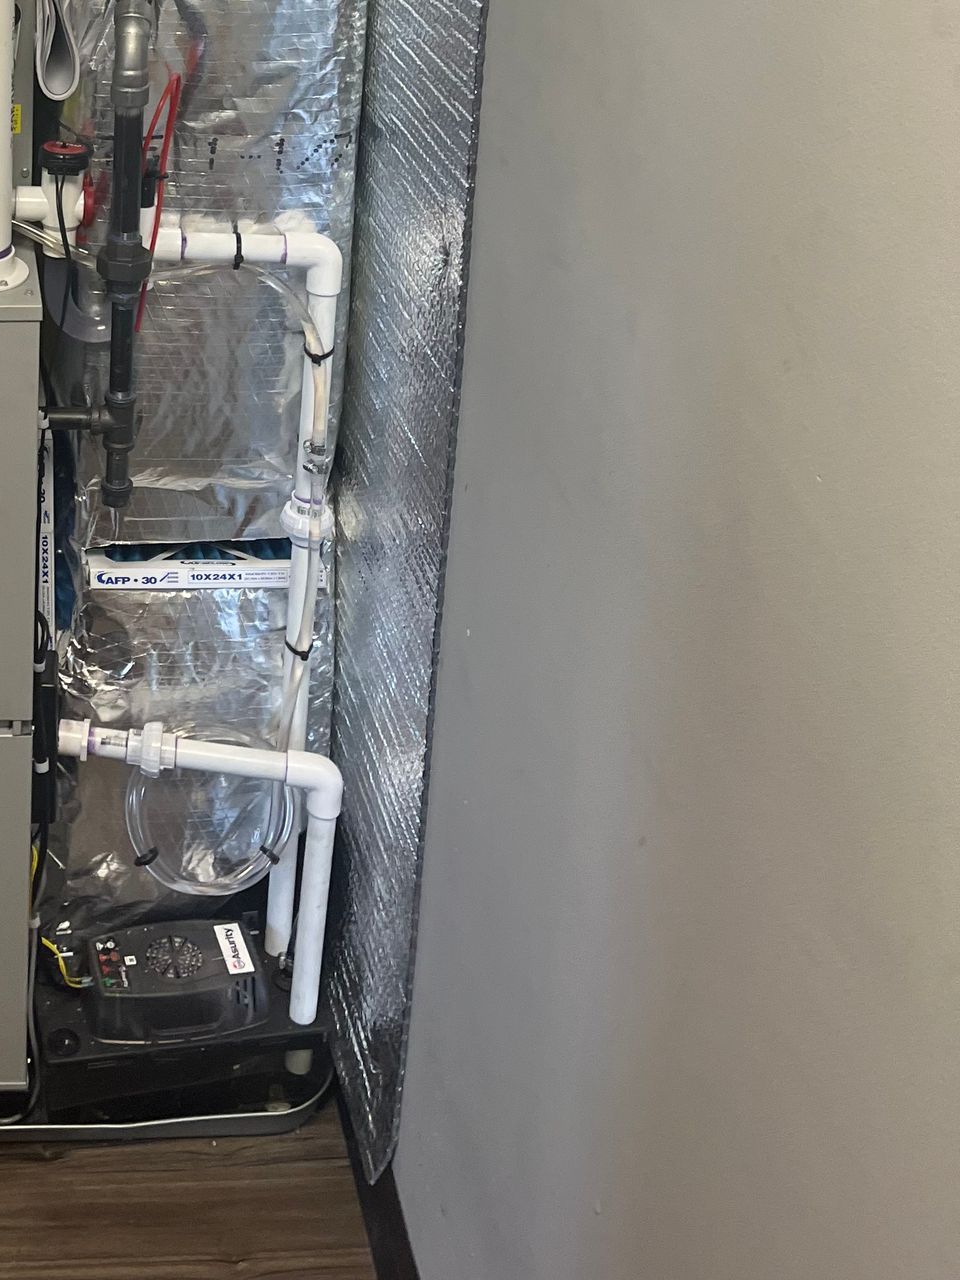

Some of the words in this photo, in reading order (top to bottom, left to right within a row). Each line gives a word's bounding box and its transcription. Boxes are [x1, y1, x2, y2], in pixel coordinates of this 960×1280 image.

[141, 576, 157, 585] 30
[190, 573, 243, 581] 10X24X1
[224, 928, 241, 959] Asurity
